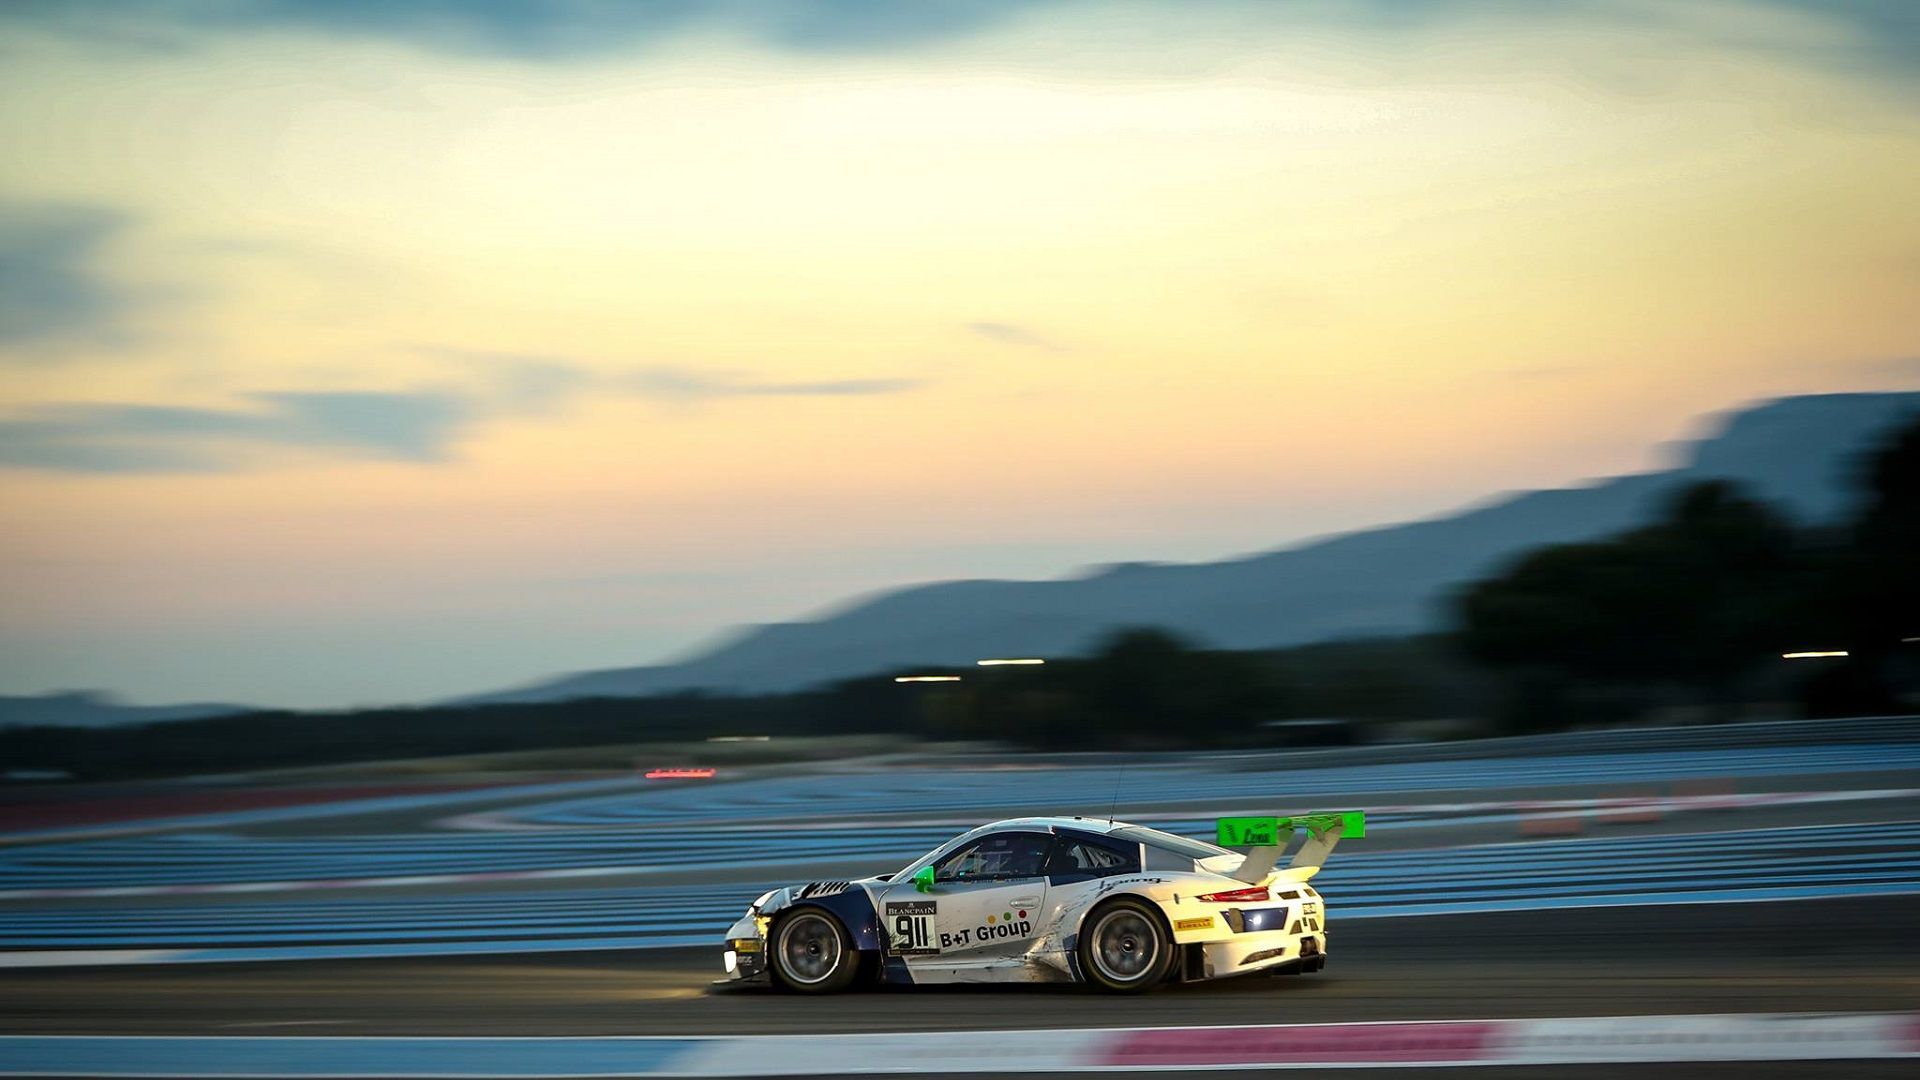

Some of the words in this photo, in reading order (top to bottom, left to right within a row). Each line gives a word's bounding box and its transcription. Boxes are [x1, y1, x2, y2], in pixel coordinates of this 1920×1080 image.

[888, 906, 935, 915] BLANCPAIN
[896, 915, 929, 949] 911
[940, 929, 970, 948] B+T
[976, 920, 1031, 941] Group
